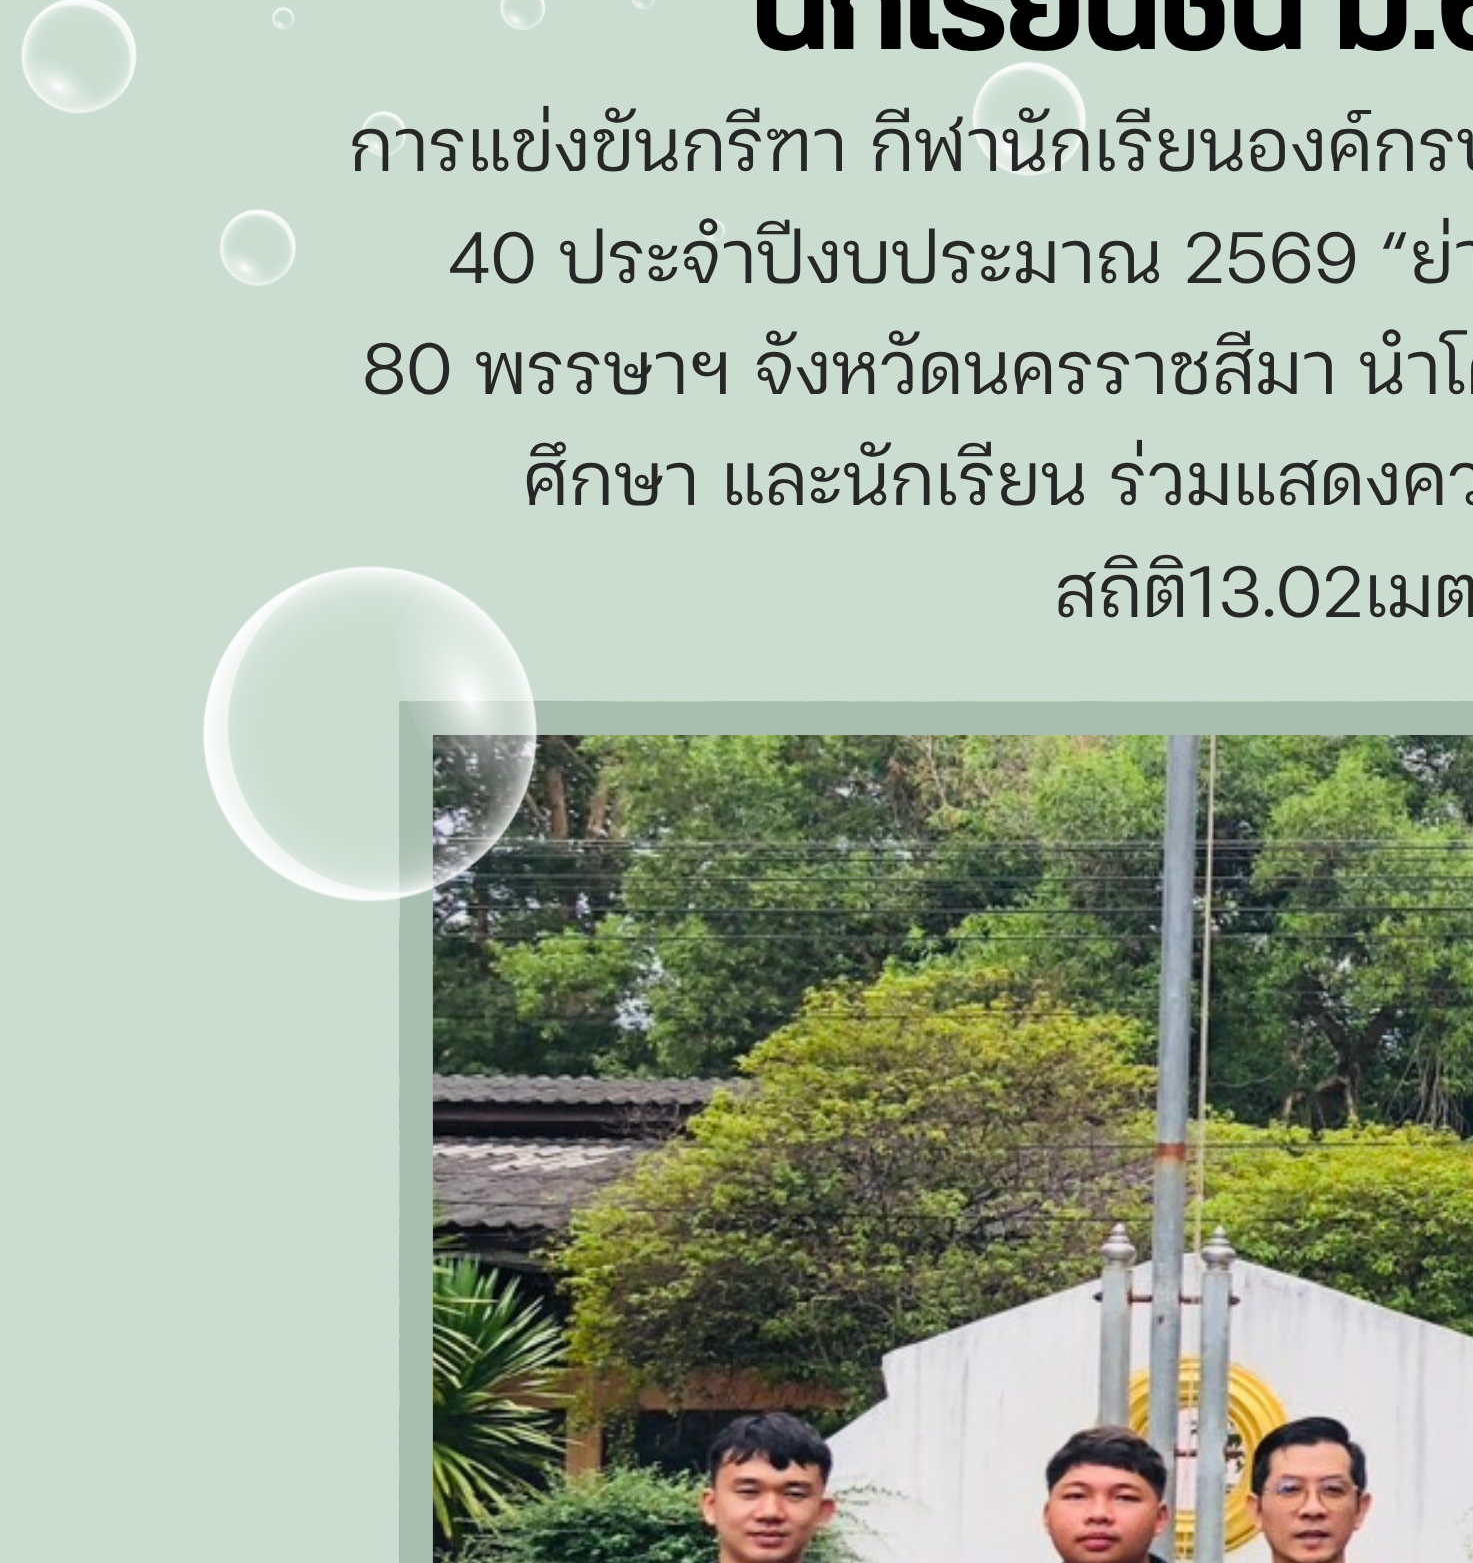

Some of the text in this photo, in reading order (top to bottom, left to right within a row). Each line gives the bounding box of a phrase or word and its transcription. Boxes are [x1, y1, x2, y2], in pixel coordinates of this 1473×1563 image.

[351, 104, 844, 173] การแข่งขันกรีฑา
[448, 230, 535, 285] 40
[558, 216, 1161, 285] ประจำปีงบประมาณ
[1186, 230, 1357, 285] 2569
[364, 341, 451, 396] 80
[474, 350, 728, 396] พรรษาฯ
[755, 329, 1334, 396] จังหวัดนครราชสีมา
[525, 440, 696, 507] ศึกษา
[725, 440, 1086, 507] และนักเรียน
